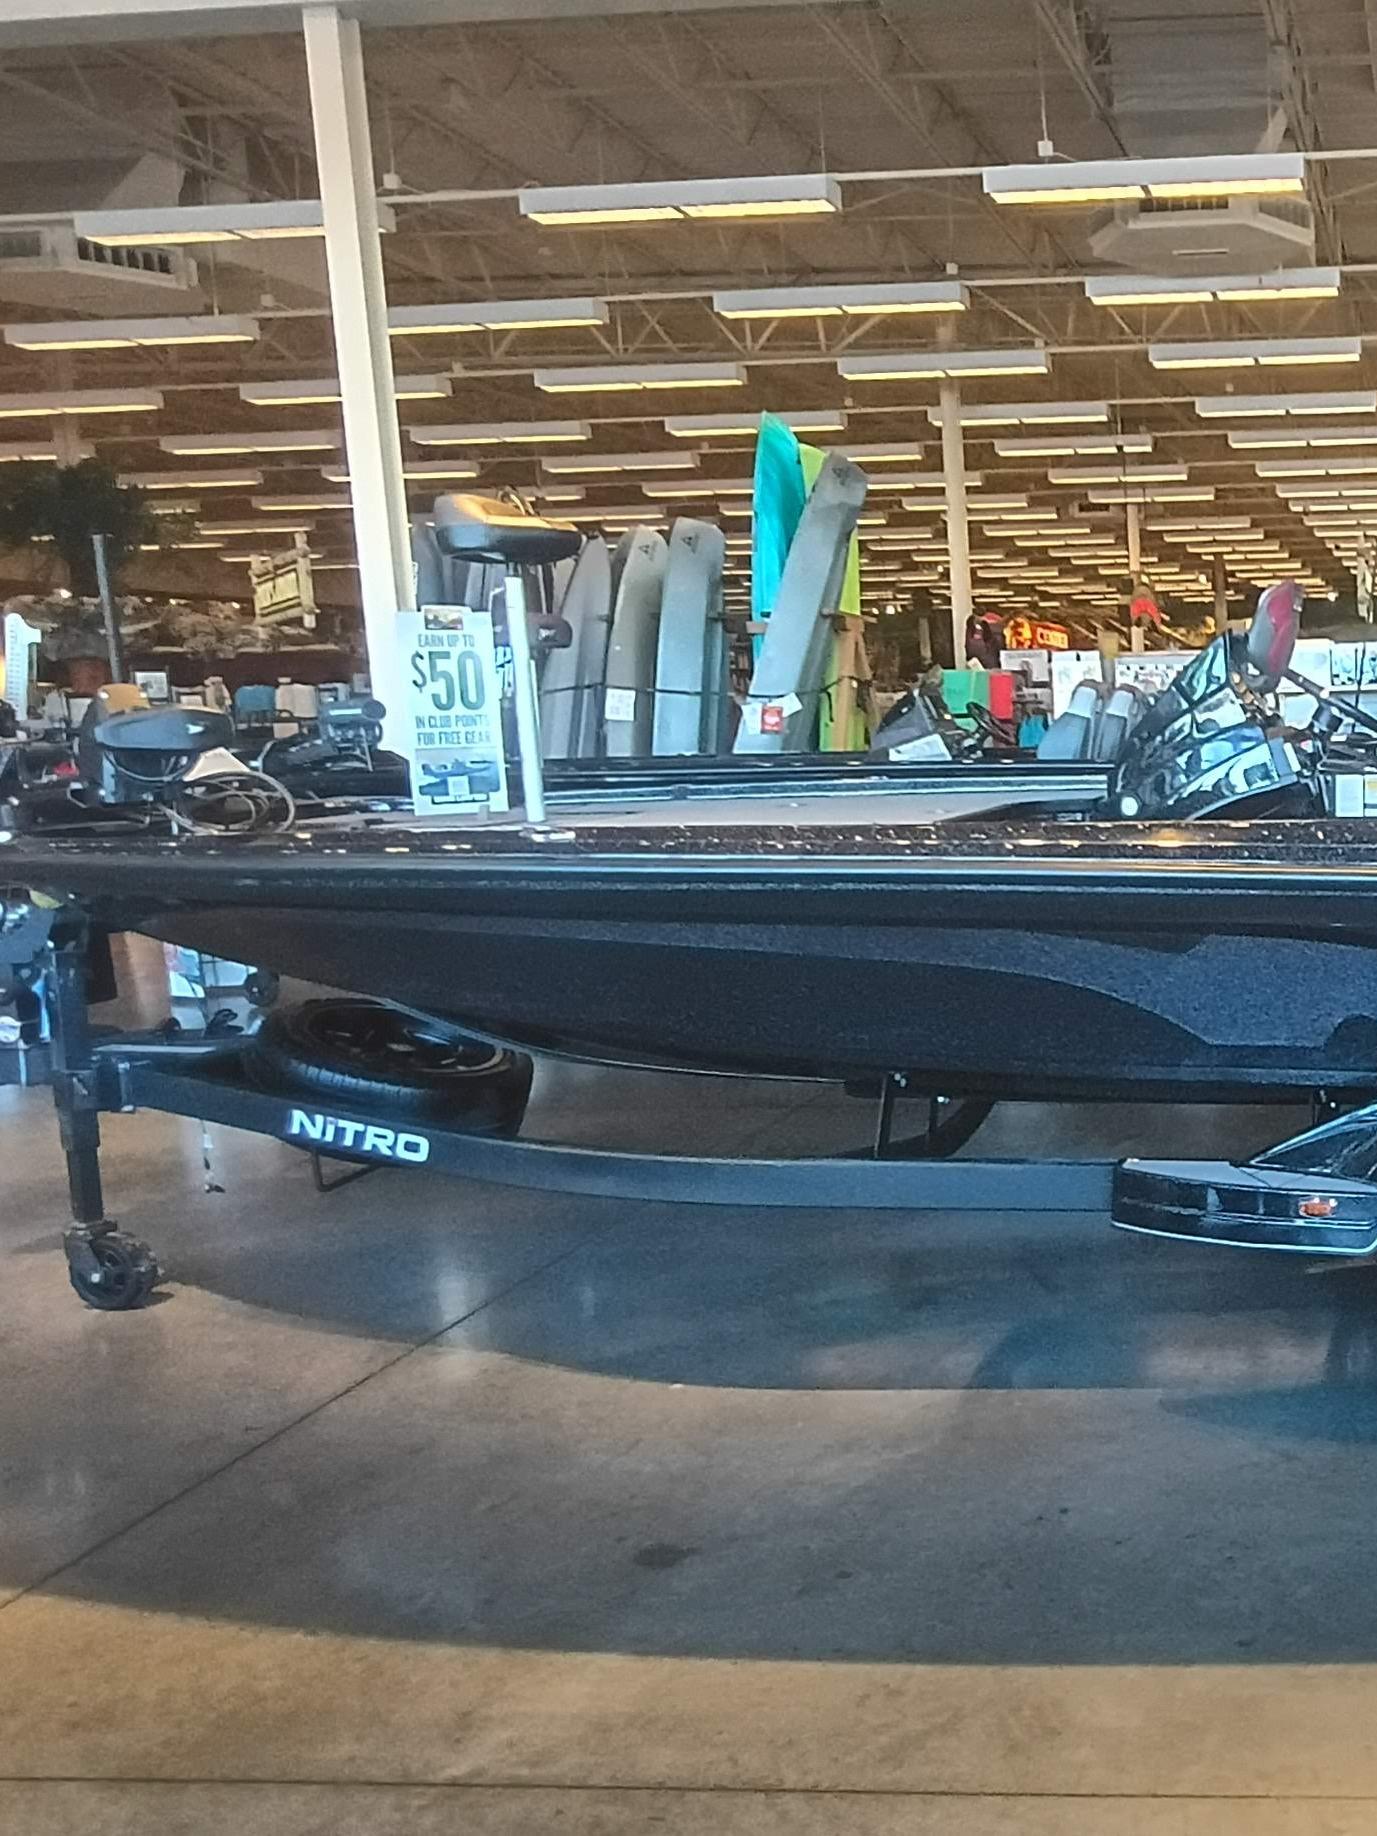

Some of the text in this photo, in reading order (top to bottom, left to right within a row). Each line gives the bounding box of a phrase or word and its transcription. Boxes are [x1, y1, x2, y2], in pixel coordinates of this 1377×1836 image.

[417, 633, 475, 648] EARN UP TO
[411, 650, 486, 711] $50
[415, 715, 426, 729] IN
[428, 714, 452, 729] CLUB
[417, 730, 491, 746] FOR FREE GEAR
